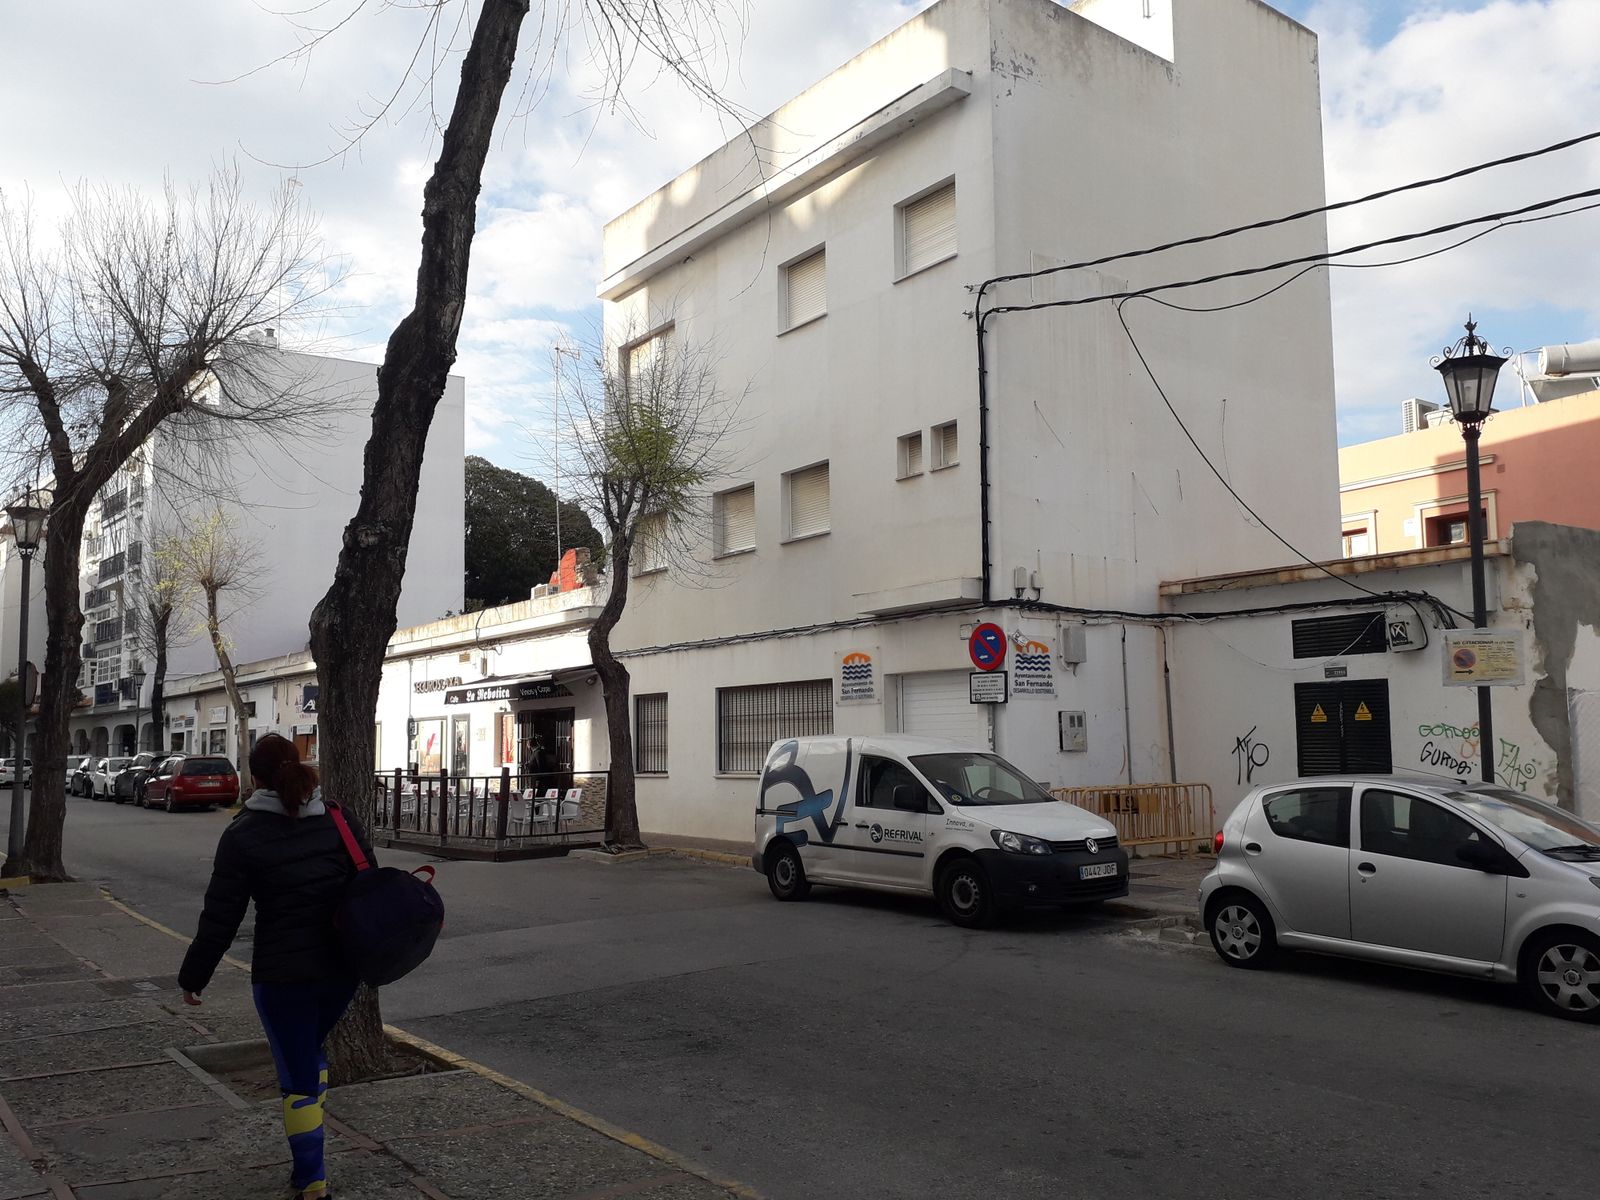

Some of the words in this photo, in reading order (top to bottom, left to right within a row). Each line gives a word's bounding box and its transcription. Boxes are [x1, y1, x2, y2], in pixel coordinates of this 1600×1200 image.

[1026, 680, 1054, 688] Fernando
[884, 828, 924, 842] REFRIVAL
[1084, 866, 1102, 877] 0442
